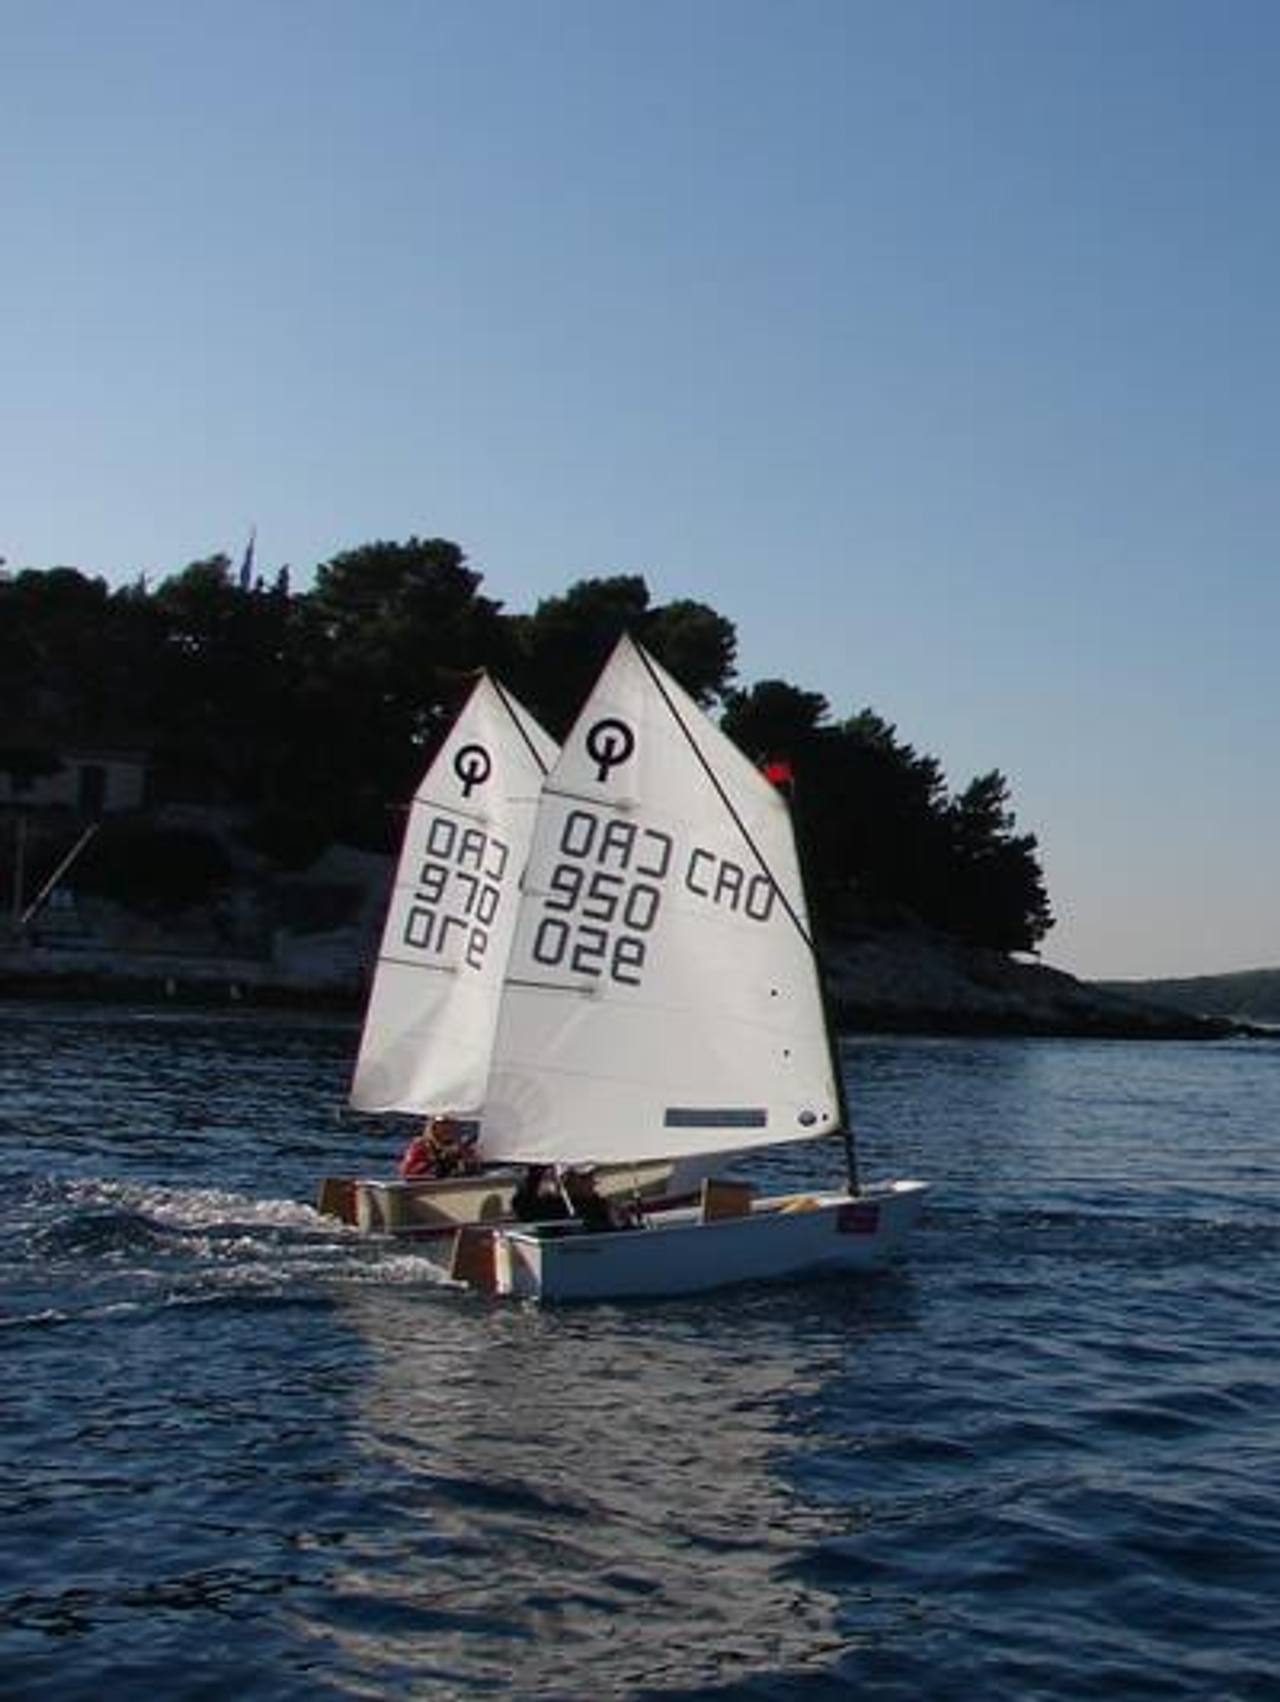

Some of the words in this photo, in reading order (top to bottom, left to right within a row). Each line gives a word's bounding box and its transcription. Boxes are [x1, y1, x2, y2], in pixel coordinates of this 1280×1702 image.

[414, 863, 500, 926] 970
[544, 864, 661, 932] 950
[686, 848, 776, 922] CRO
